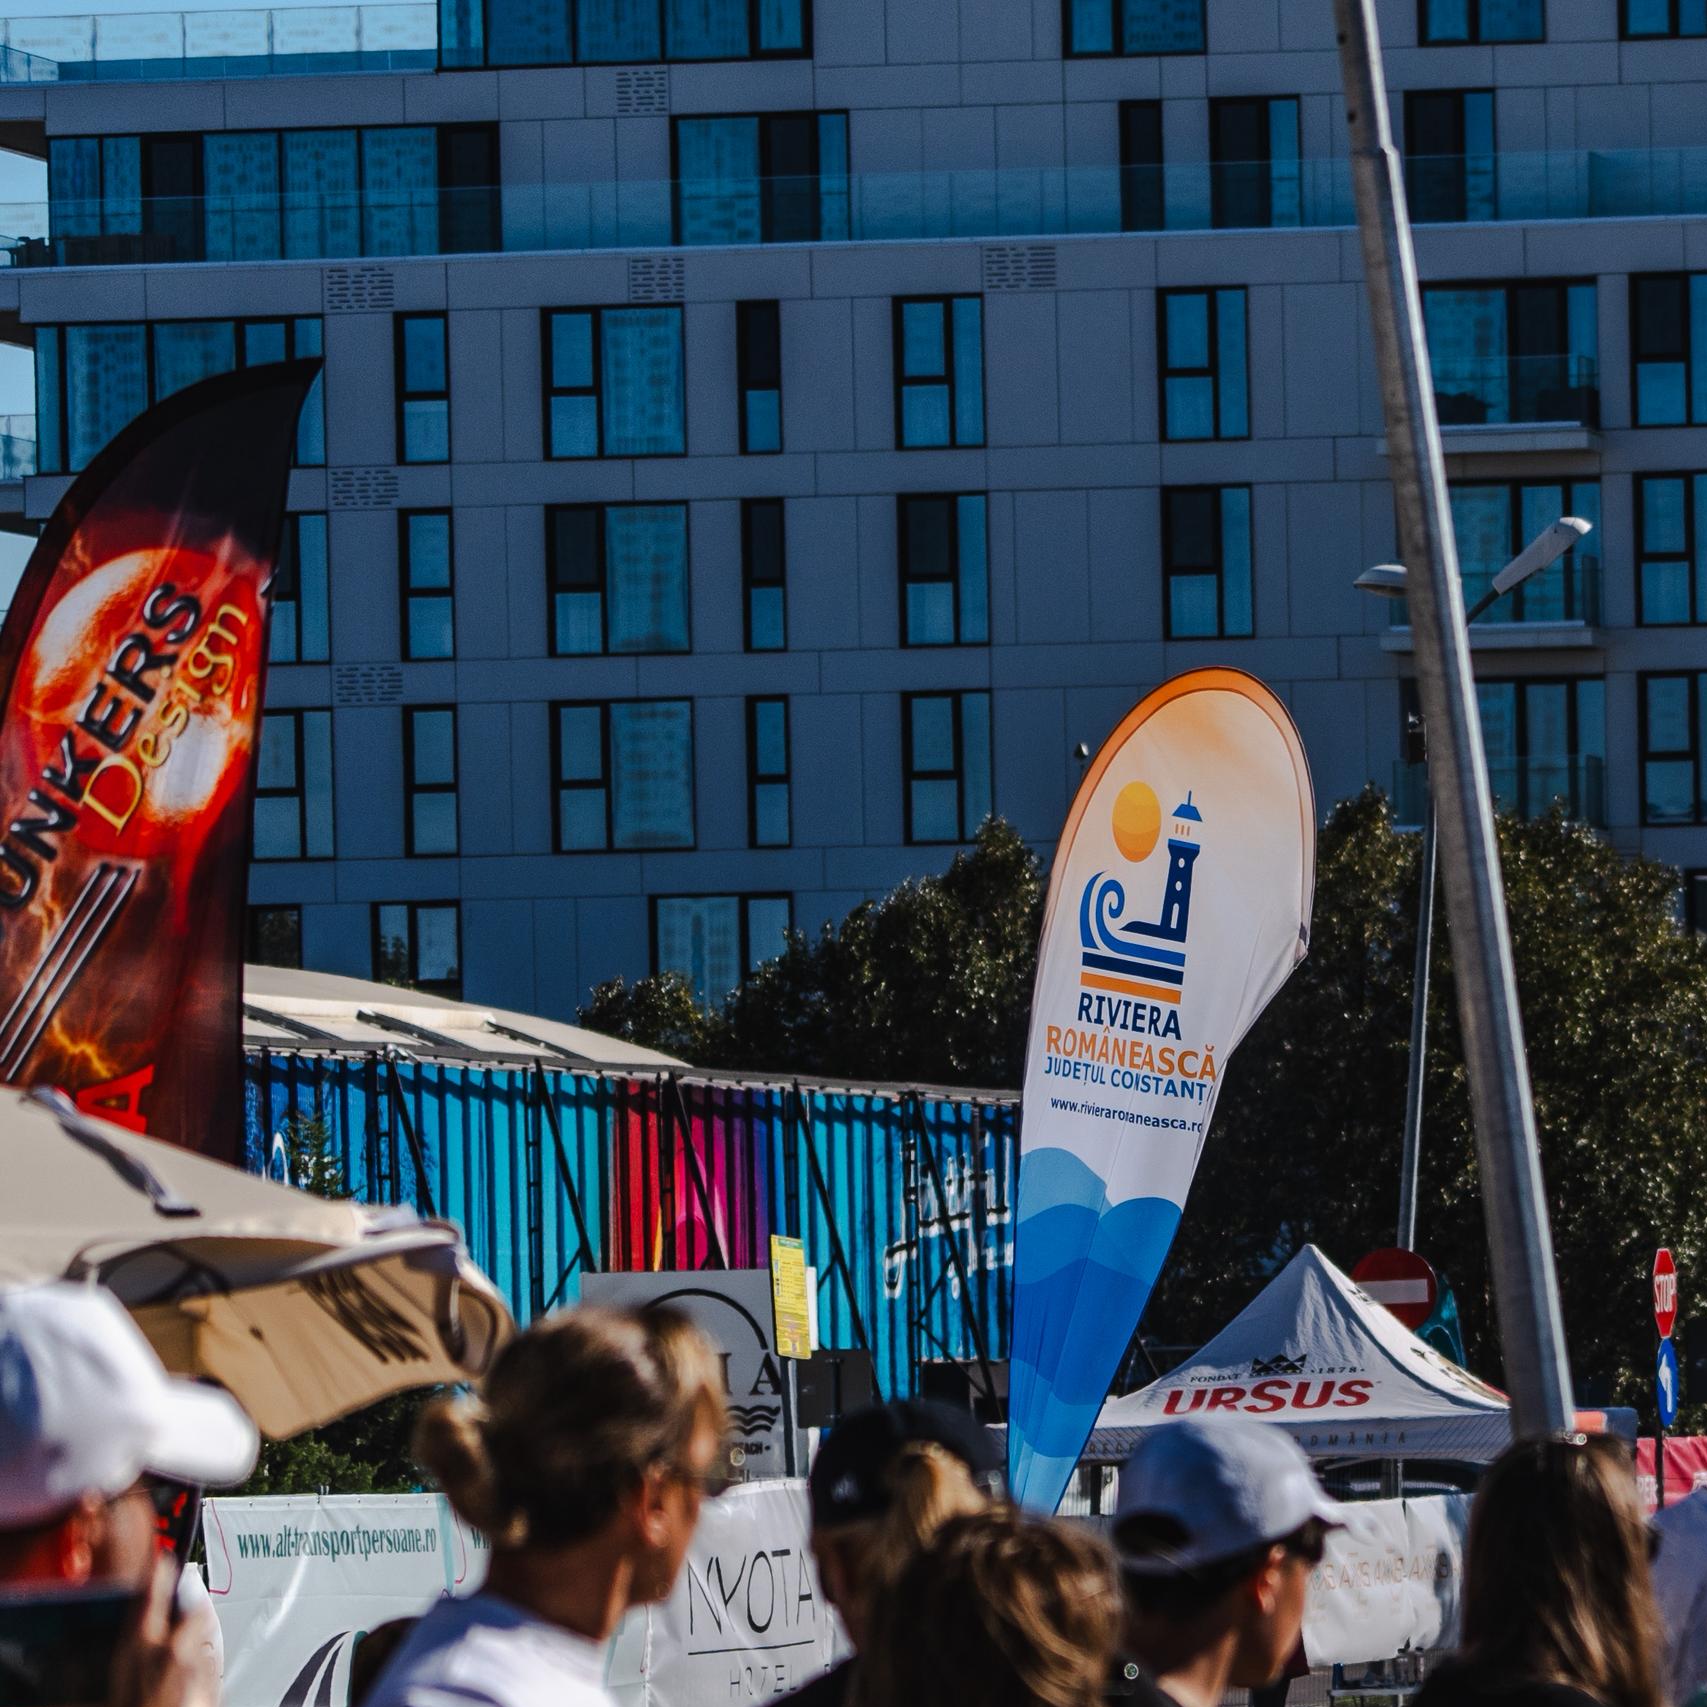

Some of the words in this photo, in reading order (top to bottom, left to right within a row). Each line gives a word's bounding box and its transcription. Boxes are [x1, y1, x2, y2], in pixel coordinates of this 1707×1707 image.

[82, 602, 248, 836] Design
[1078, 992, 1182, 1041] RIVIERA
[1046, 1026, 1217, 1082] ROMÂNEASCĂ
[1654, 1274, 1677, 1313] STOP
[1162, 1379, 1374, 1416] URSUS
[1190, 1374, 1241, 1384] FONDAT
[237, 1524, 437, 1562] www.alt-transportpersoane.ro
[688, 1549, 815, 1636] NYOTA
